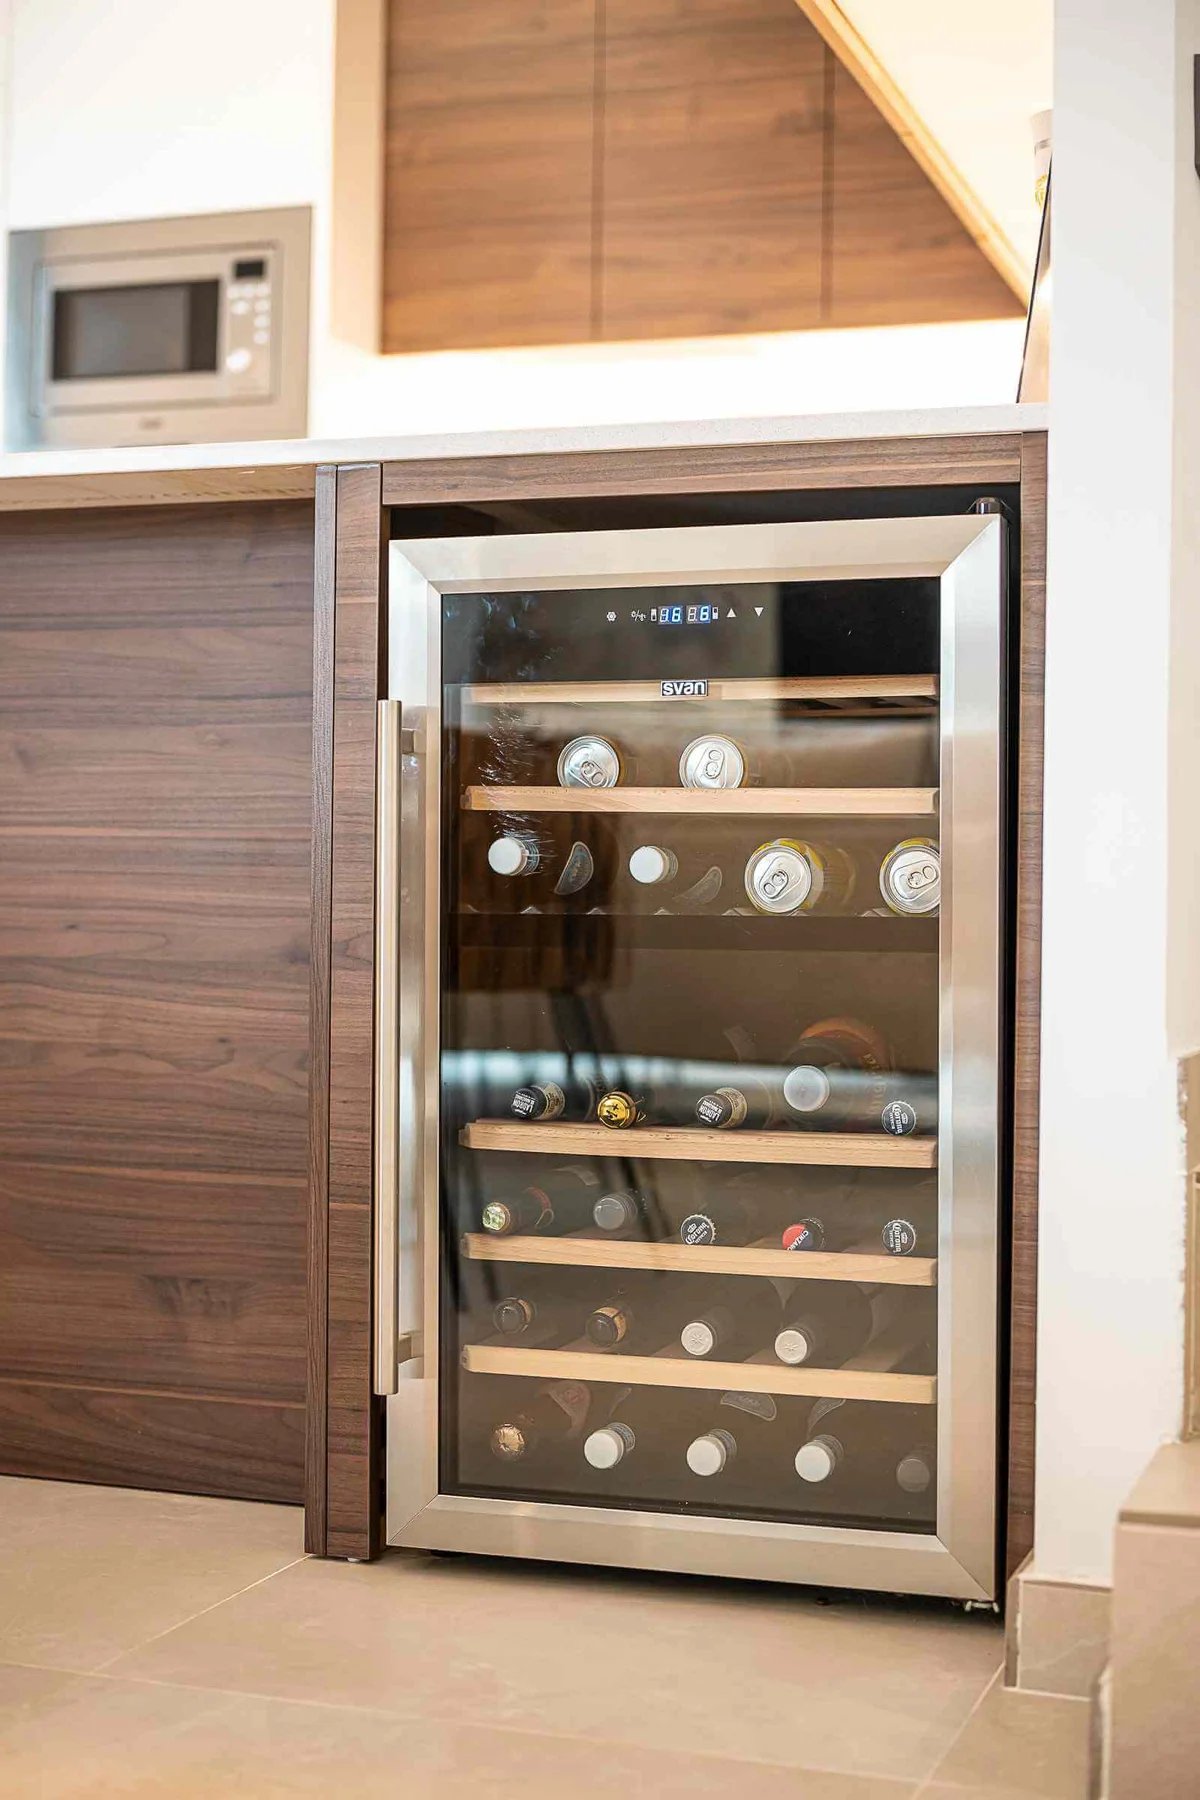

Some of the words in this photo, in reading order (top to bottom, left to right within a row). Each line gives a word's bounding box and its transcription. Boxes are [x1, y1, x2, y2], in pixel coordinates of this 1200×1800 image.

[662, 681, 705, 696] svan
[892, 1104, 903, 1134] Corona
[685, 1222, 710, 1245] Corona
[892, 1222, 902, 1253] Corona
